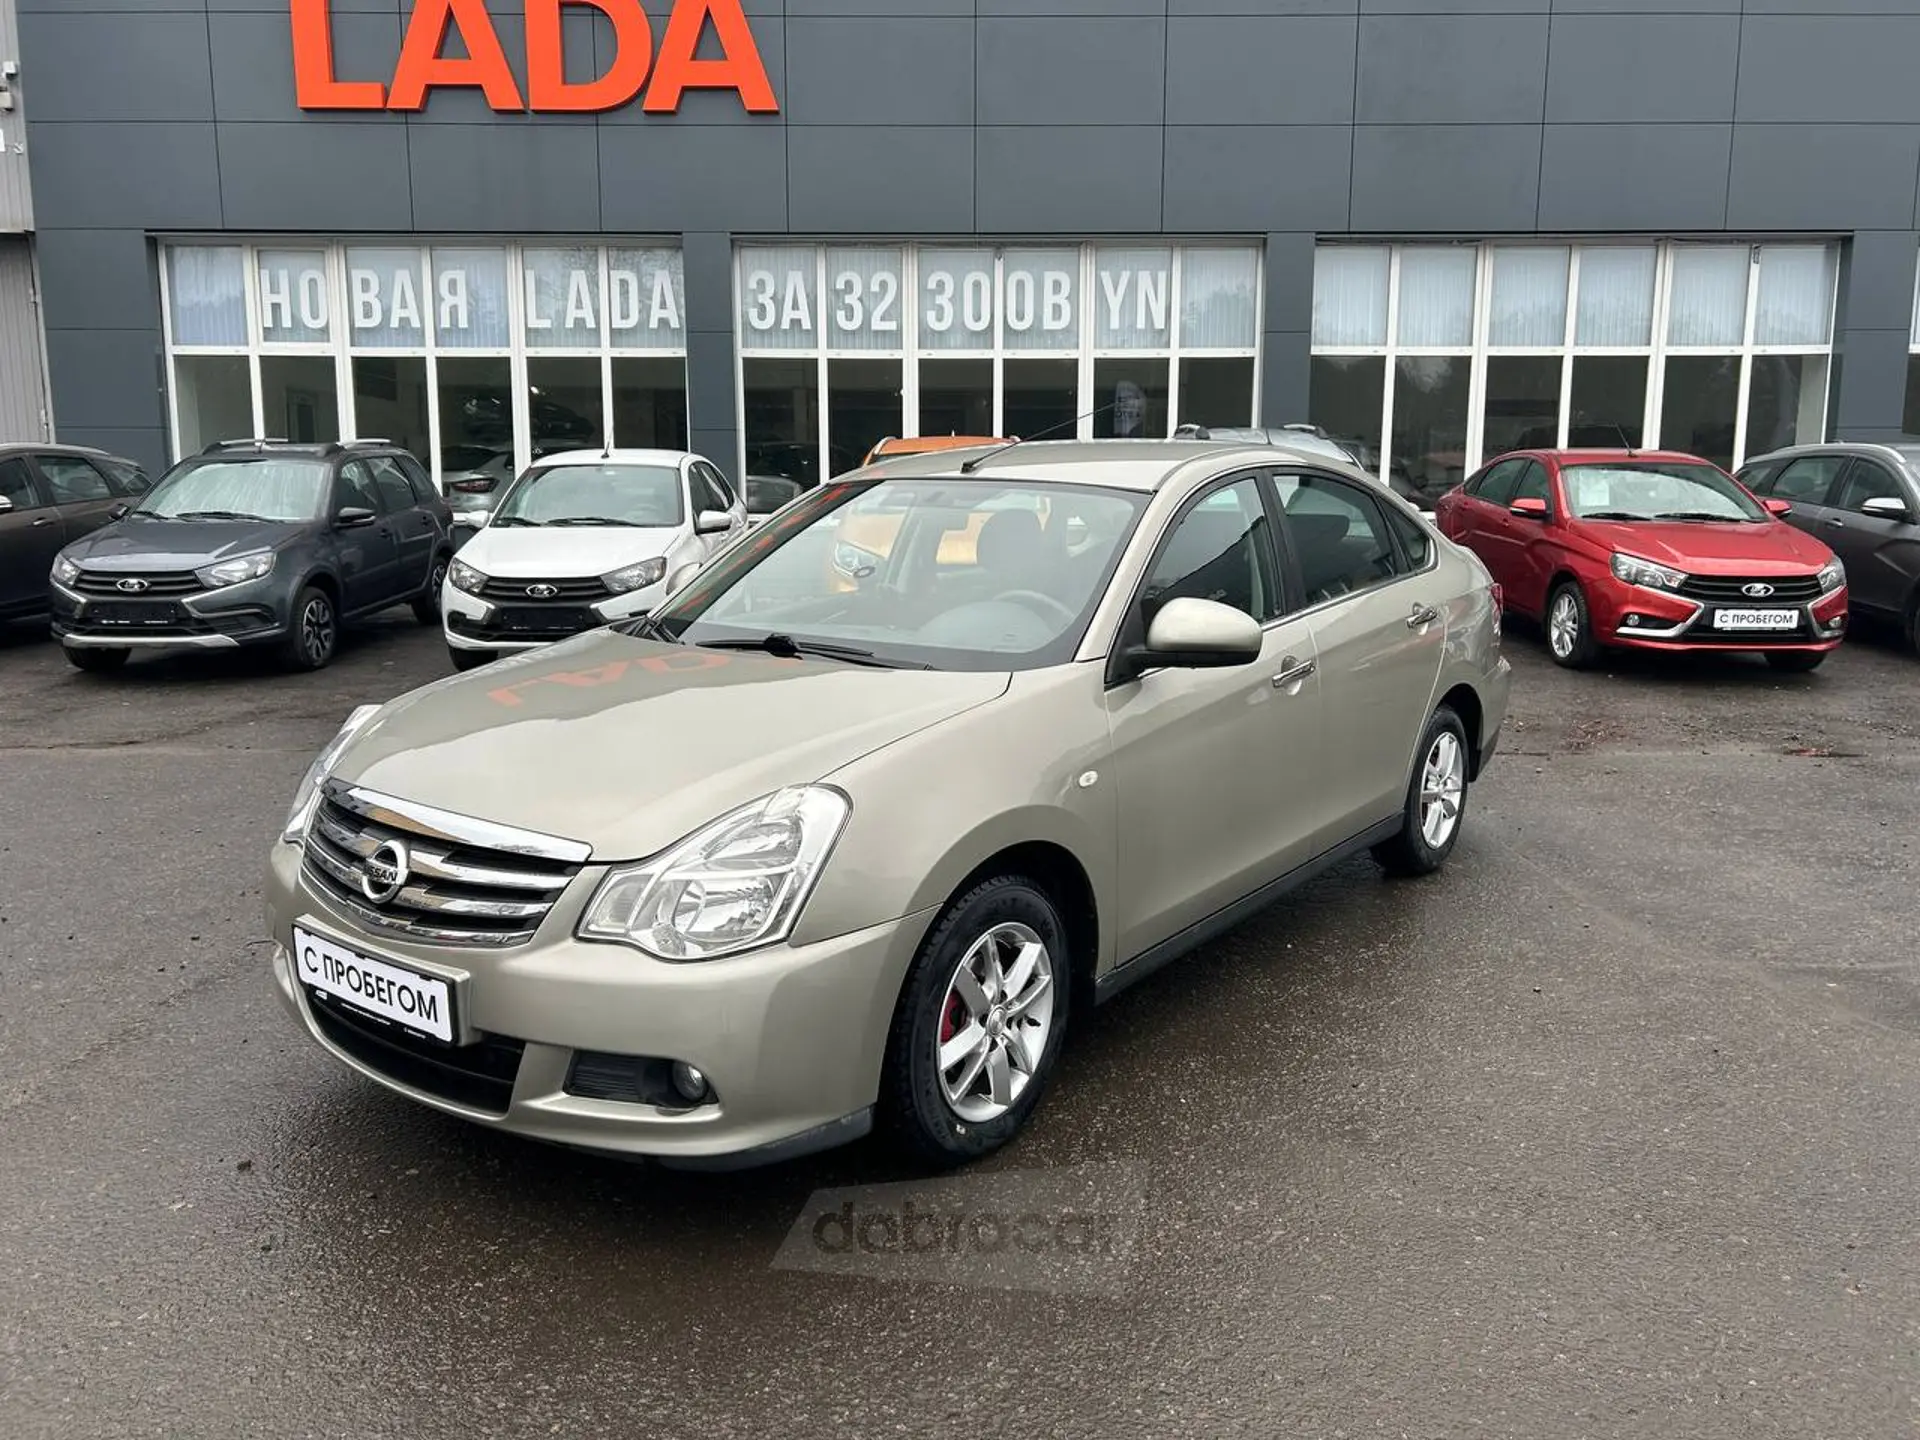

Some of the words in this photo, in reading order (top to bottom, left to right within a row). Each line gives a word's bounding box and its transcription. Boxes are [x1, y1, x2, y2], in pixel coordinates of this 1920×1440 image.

[289, 0, 780, 115] LADA
[260, 268, 469, 330] НОВАЯ
[524, 268, 681, 330] LADA
[836, 269, 898, 331] 32
[1732, 613, 1793, 624] ПРОБЕГОМ
[304, 946, 318, 973] С
[322, 953, 439, 1023] ПРОБЕГОМ
